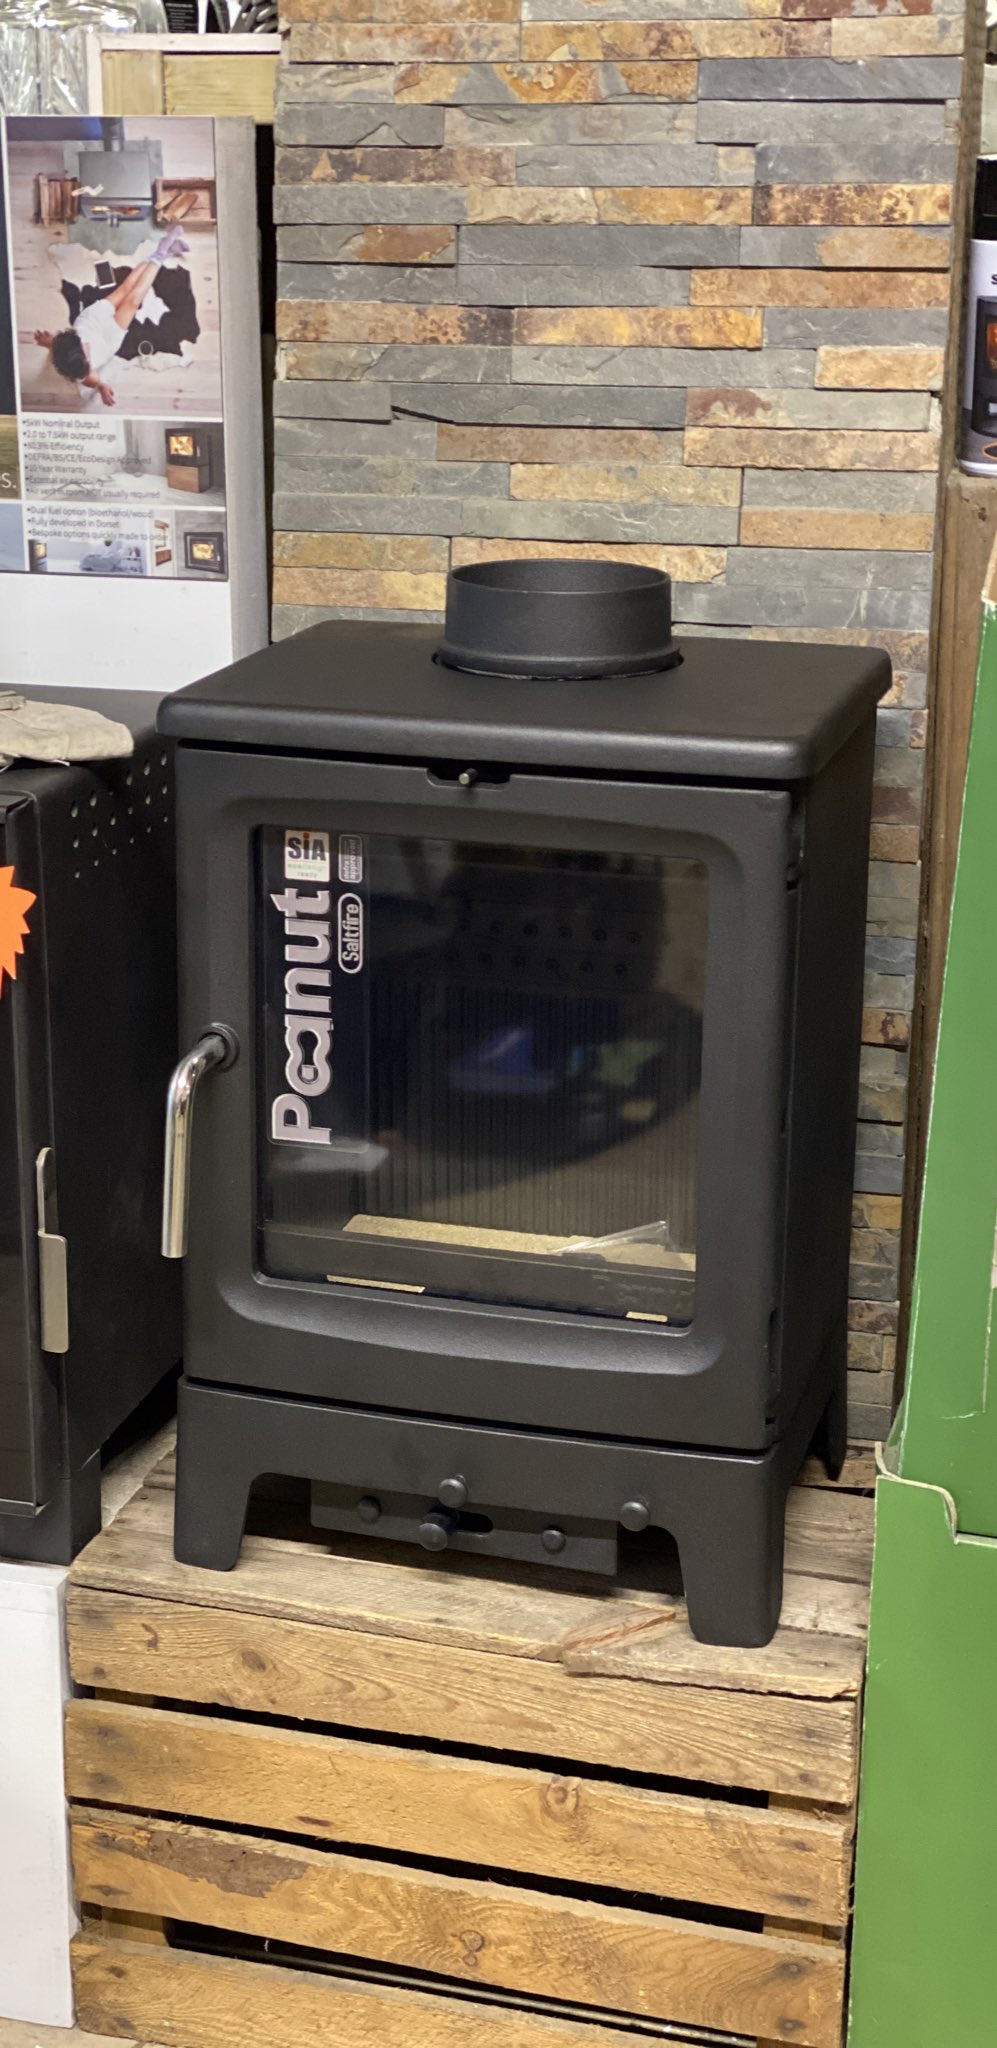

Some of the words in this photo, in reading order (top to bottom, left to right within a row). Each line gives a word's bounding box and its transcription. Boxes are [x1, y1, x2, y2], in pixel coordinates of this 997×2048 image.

[43, 419, 72, 429] Nominal
[74, 420, 100, 430] Output
[70, 432, 94, 441] output
[96, 434, 116, 443] range
[50, 443, 84, 452] Efficiency
[40, 465, 54, 473] Year
[55, 466, 86, 475] Warranty
[104, 490, 128, 499] usually
[130, 491, 160, 499] required
[30, 506, 46, 514] Dual
[48, 506, 62, 515] fuel
[63, 508, 86, 517] option
[31, 516, 49, 527] Fully
[50, 518, 86, 527] developed
[88, 519, 95, 527] in
[96, 519, 120, 528] Dorset
[32, 528, 62, 538] Bespoke
[64, 530, 90, 539] options
[92, 530, 117, 541] quickly
[118, 531, 139, 540] made
[149, 533, 168, 541] order
[342, 903, 359, 962] Saltfire
[270, 888, 333, 1144] Peanut
